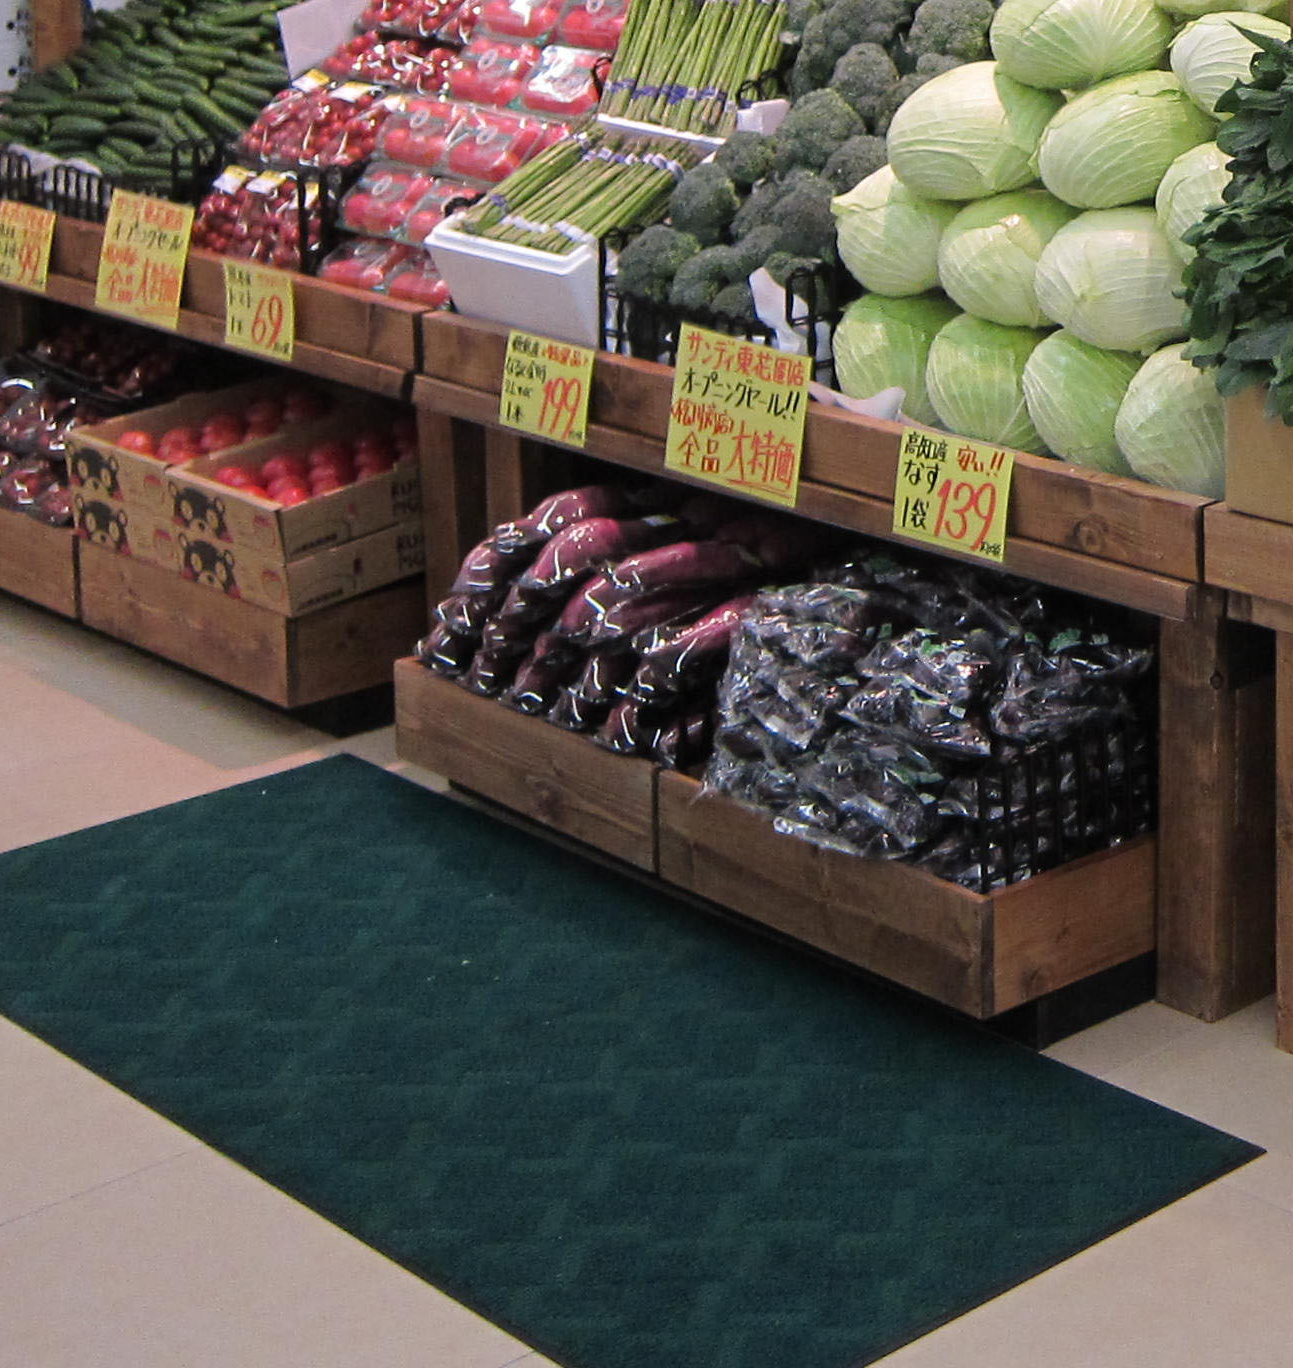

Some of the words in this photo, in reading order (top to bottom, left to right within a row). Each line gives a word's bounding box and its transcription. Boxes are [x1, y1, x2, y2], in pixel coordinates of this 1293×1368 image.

[251, 294, 283, 348] 69
[688, 332, 805, 386] サンディ東花園店
[538, 377, 582, 441] 199
[682, 367, 801, 420] オープニングセール!!
[678, 431, 720, 473] 全品
[725, 420, 796, 489] 大特価
[904, 459, 940, 494] なす
[958, 445, 1006, 477] 安い!!
[902, 497, 929, 530] 1袋
[934, 479, 997, 551] 139
